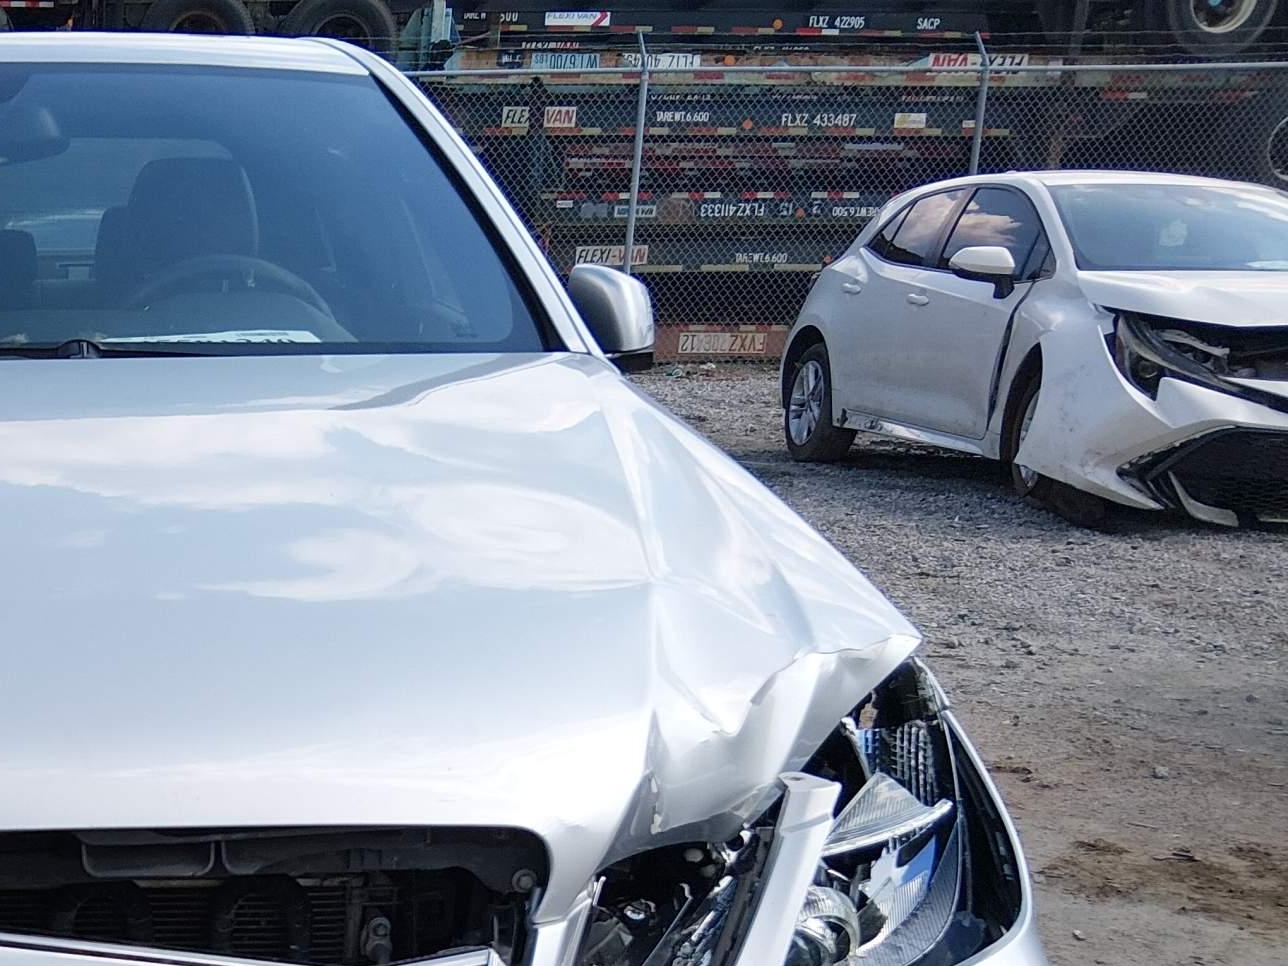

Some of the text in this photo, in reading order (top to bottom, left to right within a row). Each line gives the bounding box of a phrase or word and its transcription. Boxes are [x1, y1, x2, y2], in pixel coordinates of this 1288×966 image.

[809, 16, 866, 29] FLXZ 422905
[916, 18, 942, 30] SACP
[781, 113, 858, 127] FLXZ 433487
